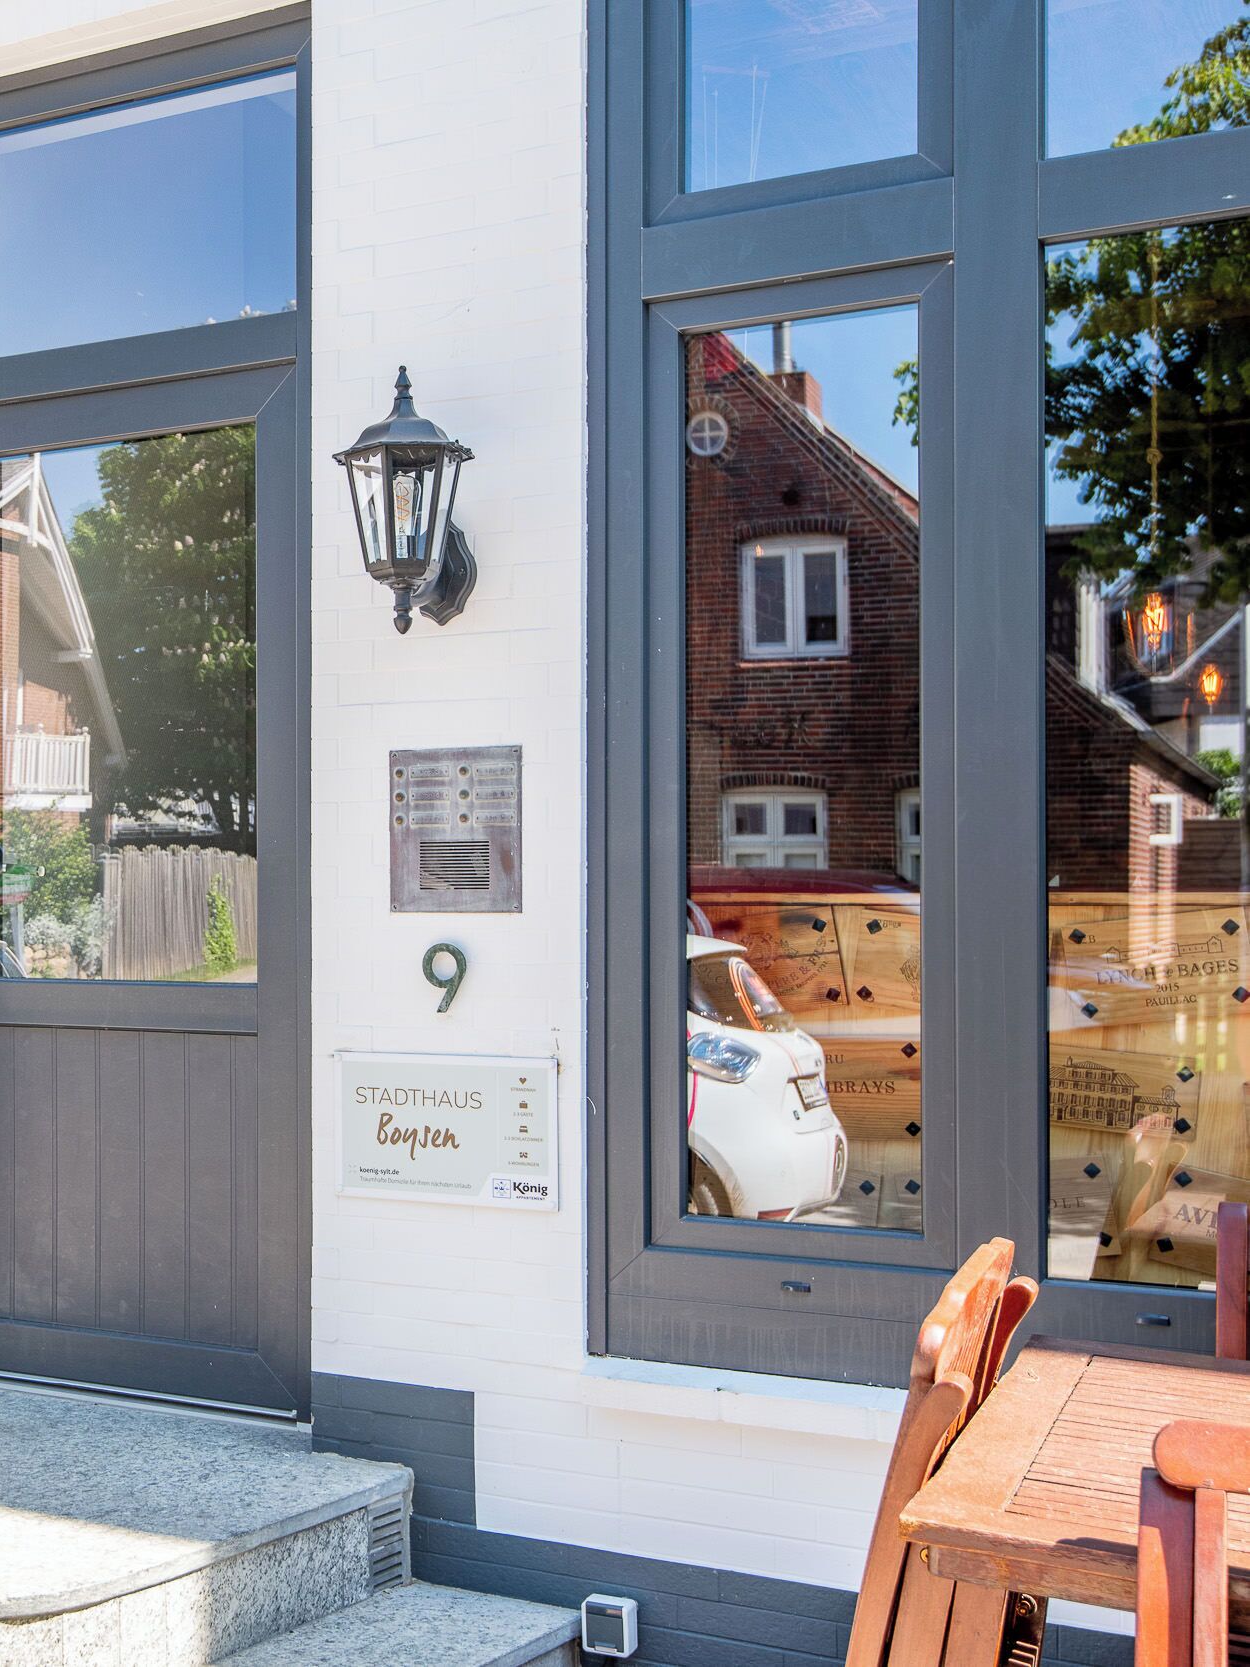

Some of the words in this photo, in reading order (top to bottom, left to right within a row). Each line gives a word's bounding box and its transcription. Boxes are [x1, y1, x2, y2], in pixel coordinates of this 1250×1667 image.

[422, 942, 467, 1013] 9
[1096, 967, 1157, 985] LYNCH
[1177, 959, 1240, 978] BAGES
[1155, 982, 1180, 993] 2015
[825, 1054, 844, 1064] RU
[355, 1086, 482, 1110] STADTHAUS
[376, 1112, 460, 1160] Boysen
[359, 1166, 400, 1176] koenig-sylt.de
[513, 1182, 548, 1197] König
[1173, 1203, 1219, 1228] AVI
